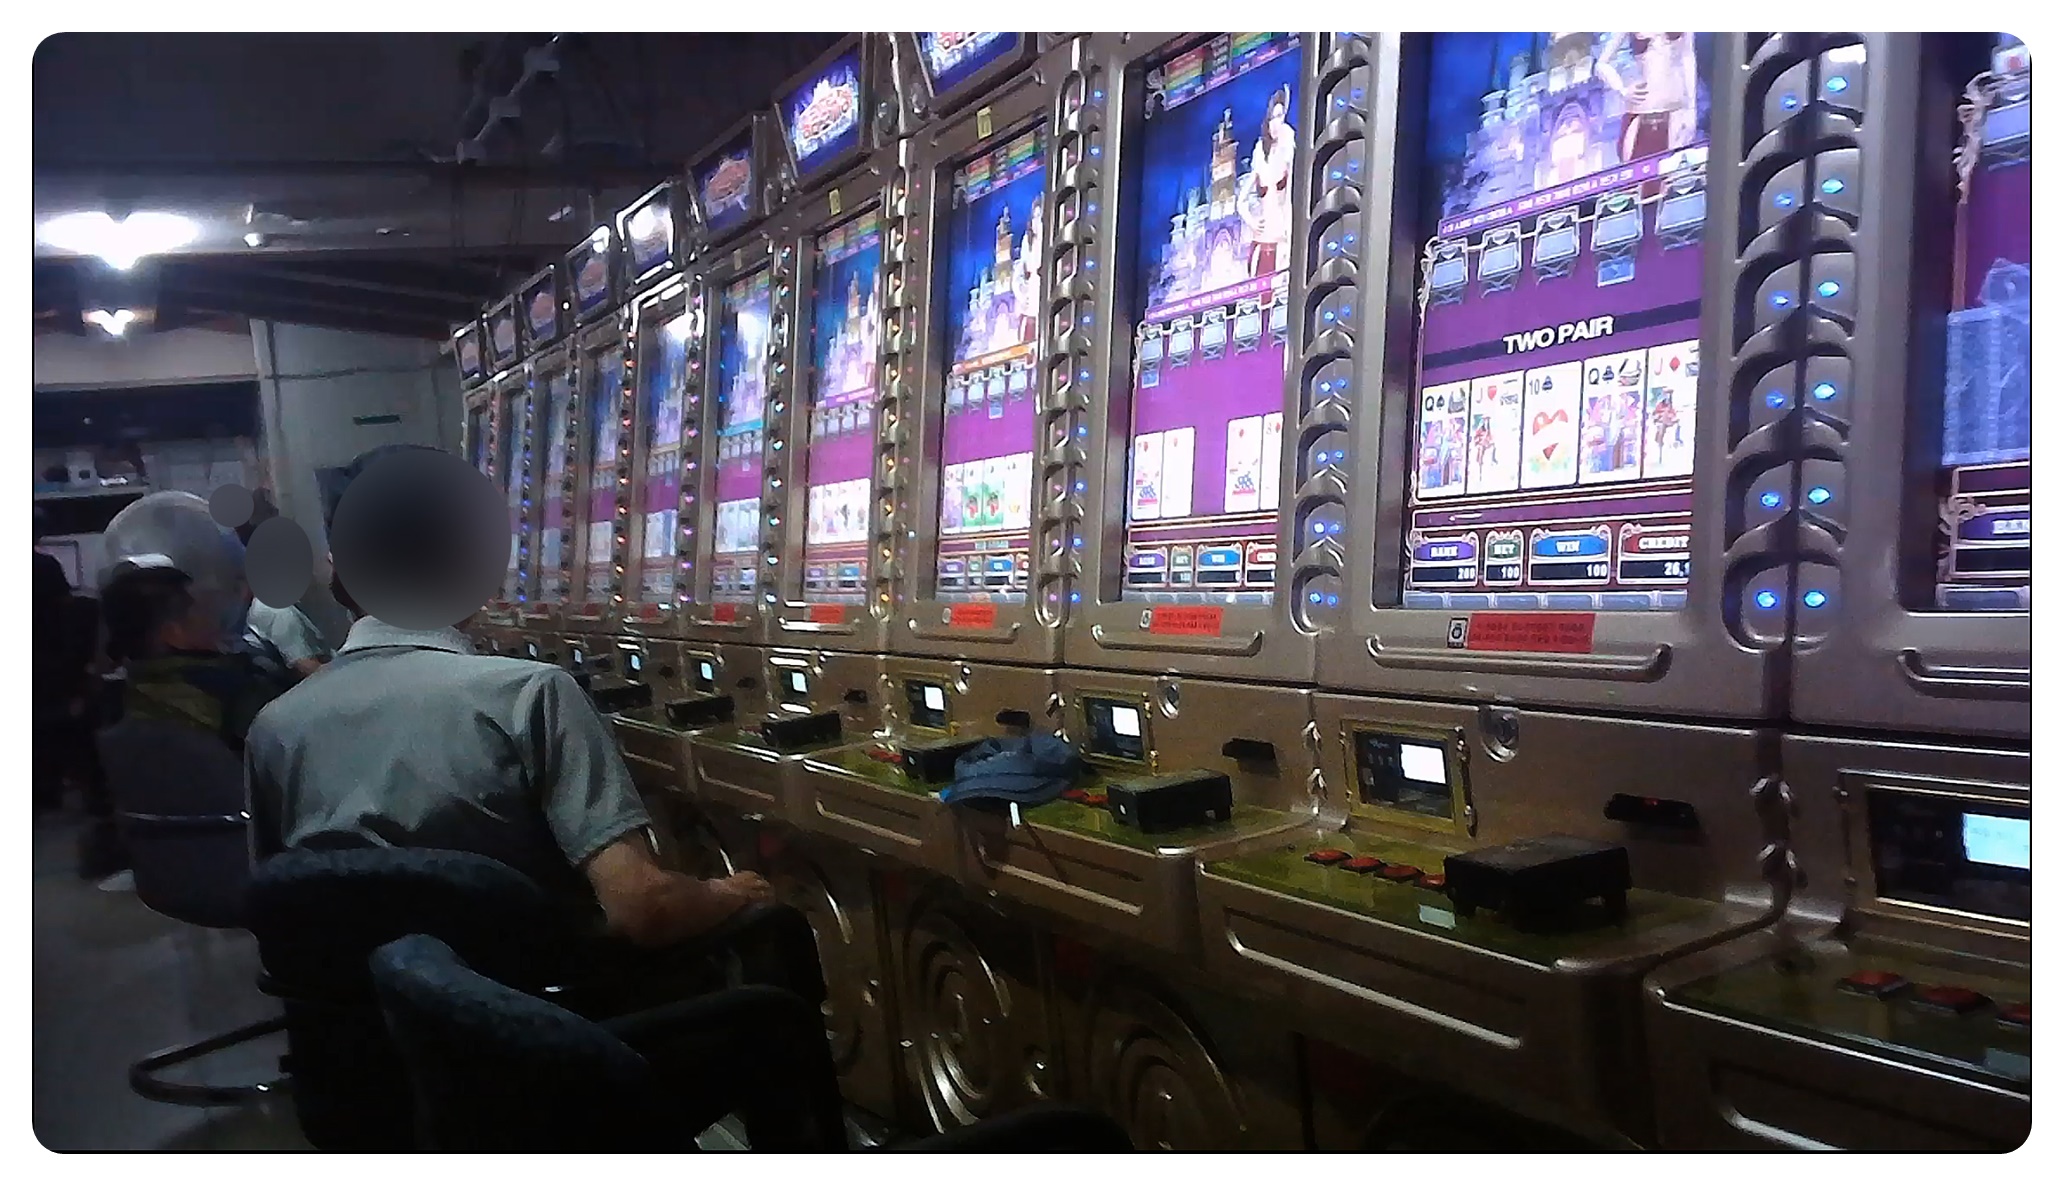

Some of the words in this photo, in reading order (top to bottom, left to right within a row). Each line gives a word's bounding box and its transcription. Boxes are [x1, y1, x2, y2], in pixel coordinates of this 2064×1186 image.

[1503, 328, 1555, 354] TWO
[1557, 315, 1614, 344] PAIR
[1588, 367, 1599, 385] Q
[1529, 378, 1540, 395] 10
[1425, 395, 1434, 412] Q
[1554, 540, 1580, 553] WIN
[1501, 565, 1520, 579] 100
[1586, 563, 1608, 578] 100
